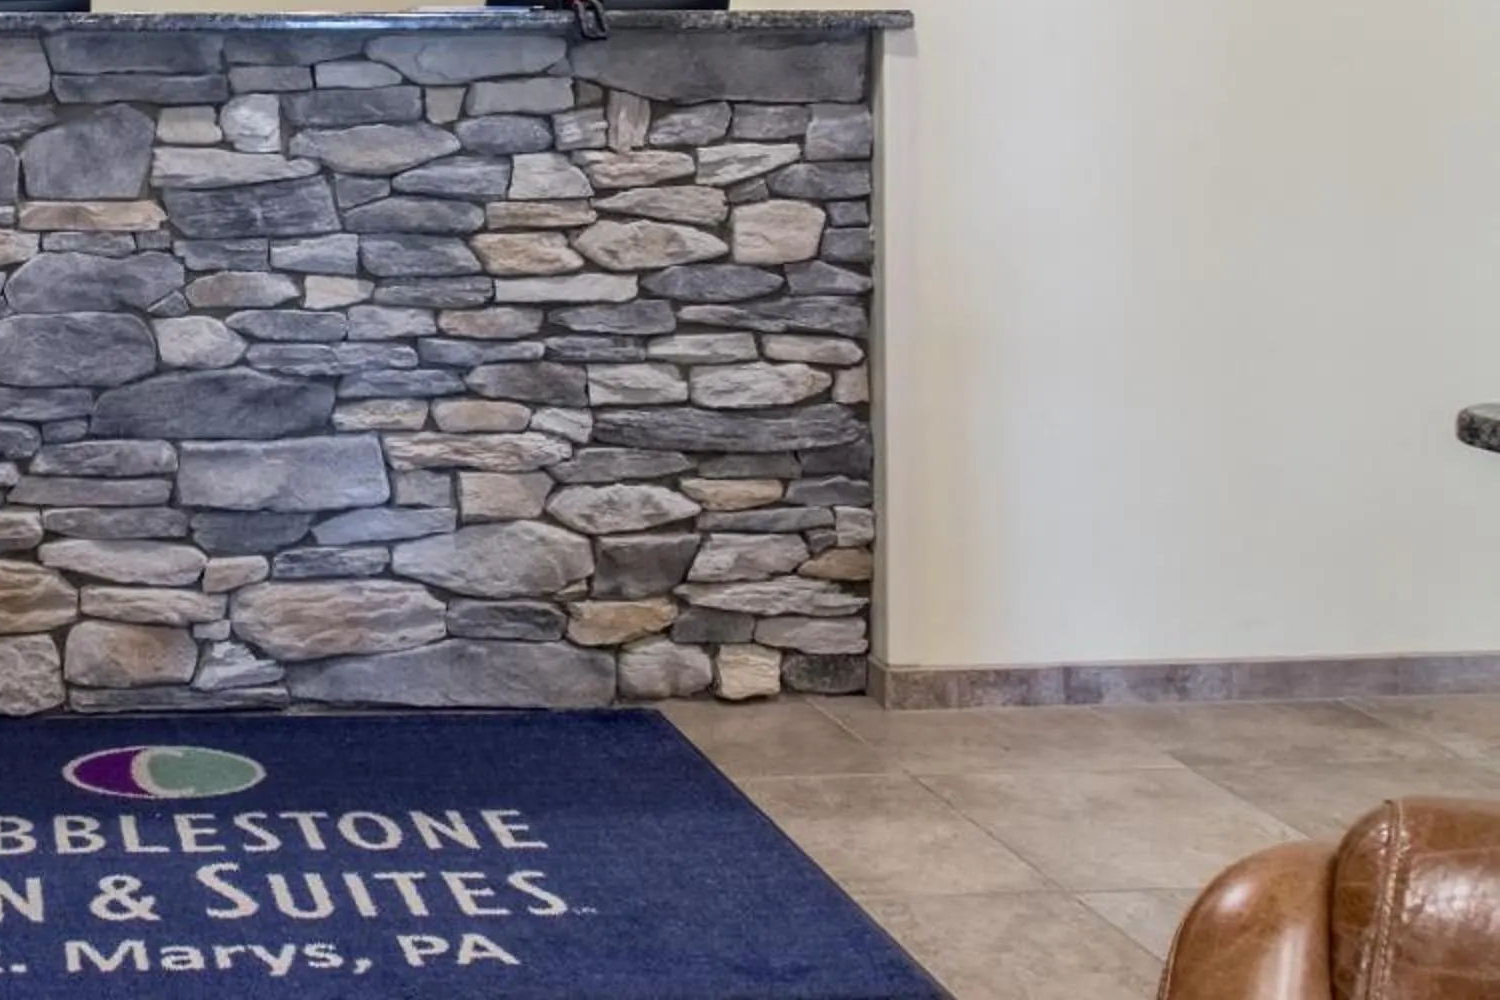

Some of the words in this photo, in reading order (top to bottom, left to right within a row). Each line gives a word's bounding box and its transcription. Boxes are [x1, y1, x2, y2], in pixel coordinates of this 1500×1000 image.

[89, 874, 161, 921] &
[196, 861, 568, 919] SUITES
[63, 938, 372, 977] Marys,
[396, 933, 521, 967] PA
